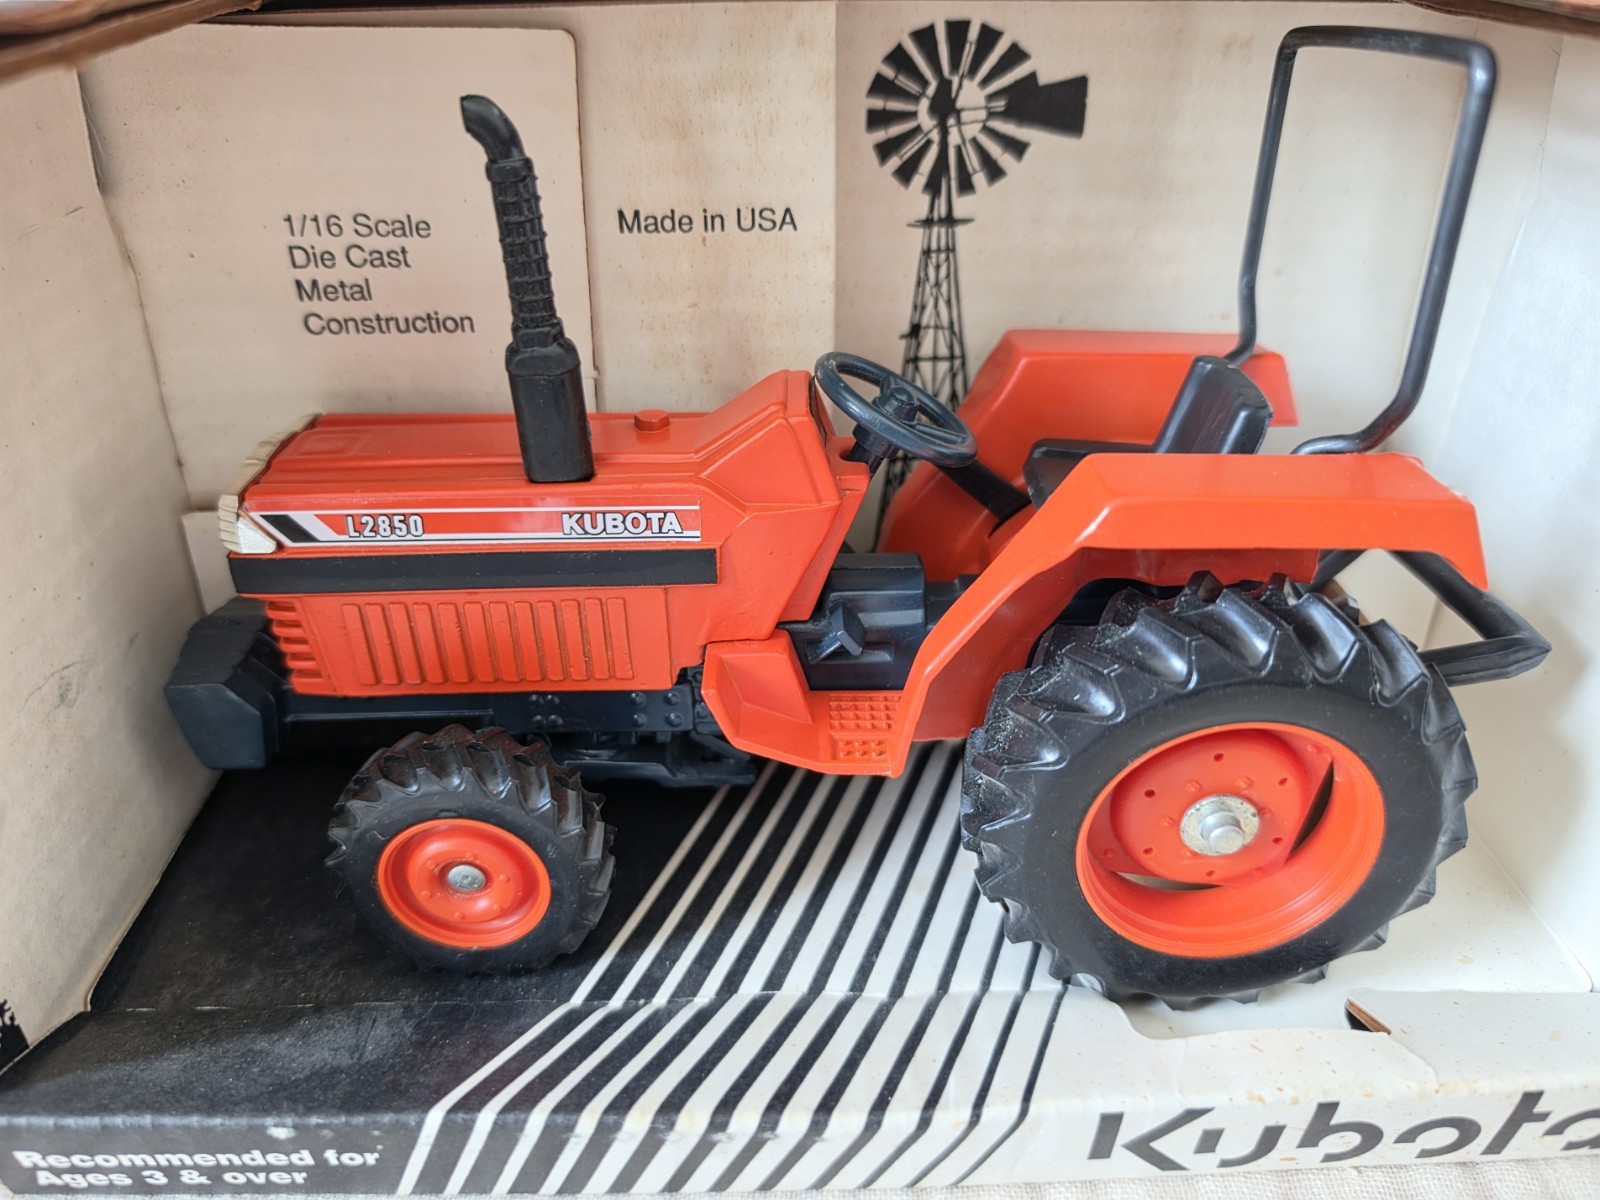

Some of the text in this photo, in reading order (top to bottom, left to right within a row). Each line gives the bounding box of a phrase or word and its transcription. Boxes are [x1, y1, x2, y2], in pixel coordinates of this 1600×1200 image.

[283, 213, 433, 238] 1/16 Scale
[618, 207, 798, 234] Made in USA
[288, 244, 411, 269] Die Cast
[295, 278, 372, 302] Metal
[303, 310, 476, 336] Construction
[346, 514, 424, 538] L2850
[562, 511, 684, 536] KUBOTA
[12, 1150, 381, 1169] Recommended for
[36, 1170, 308, 1189] Ages 3 & over
